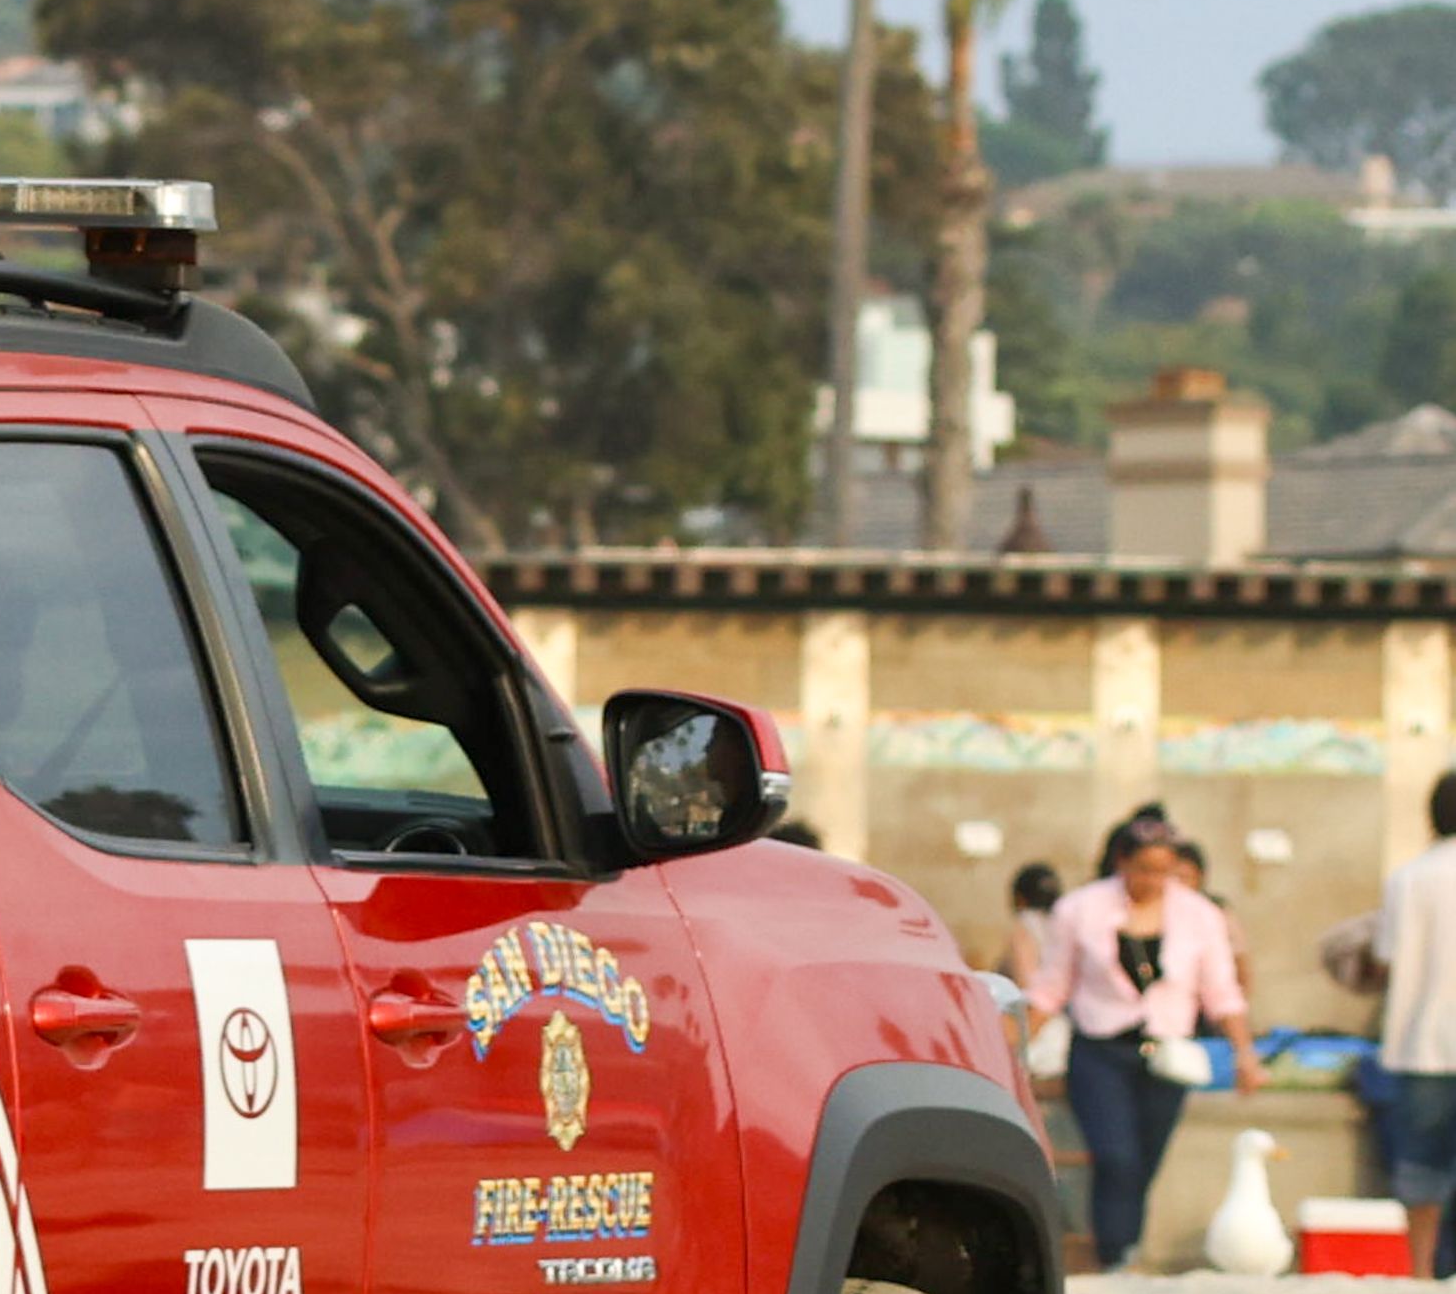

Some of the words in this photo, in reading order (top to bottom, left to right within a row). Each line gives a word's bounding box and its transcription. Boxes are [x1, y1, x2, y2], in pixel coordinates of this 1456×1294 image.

[466, 925, 533, 1062] SAN
[527, 920, 651, 1054] DIEGO
[472, 1172, 653, 1245] FIRE-RESCUE
